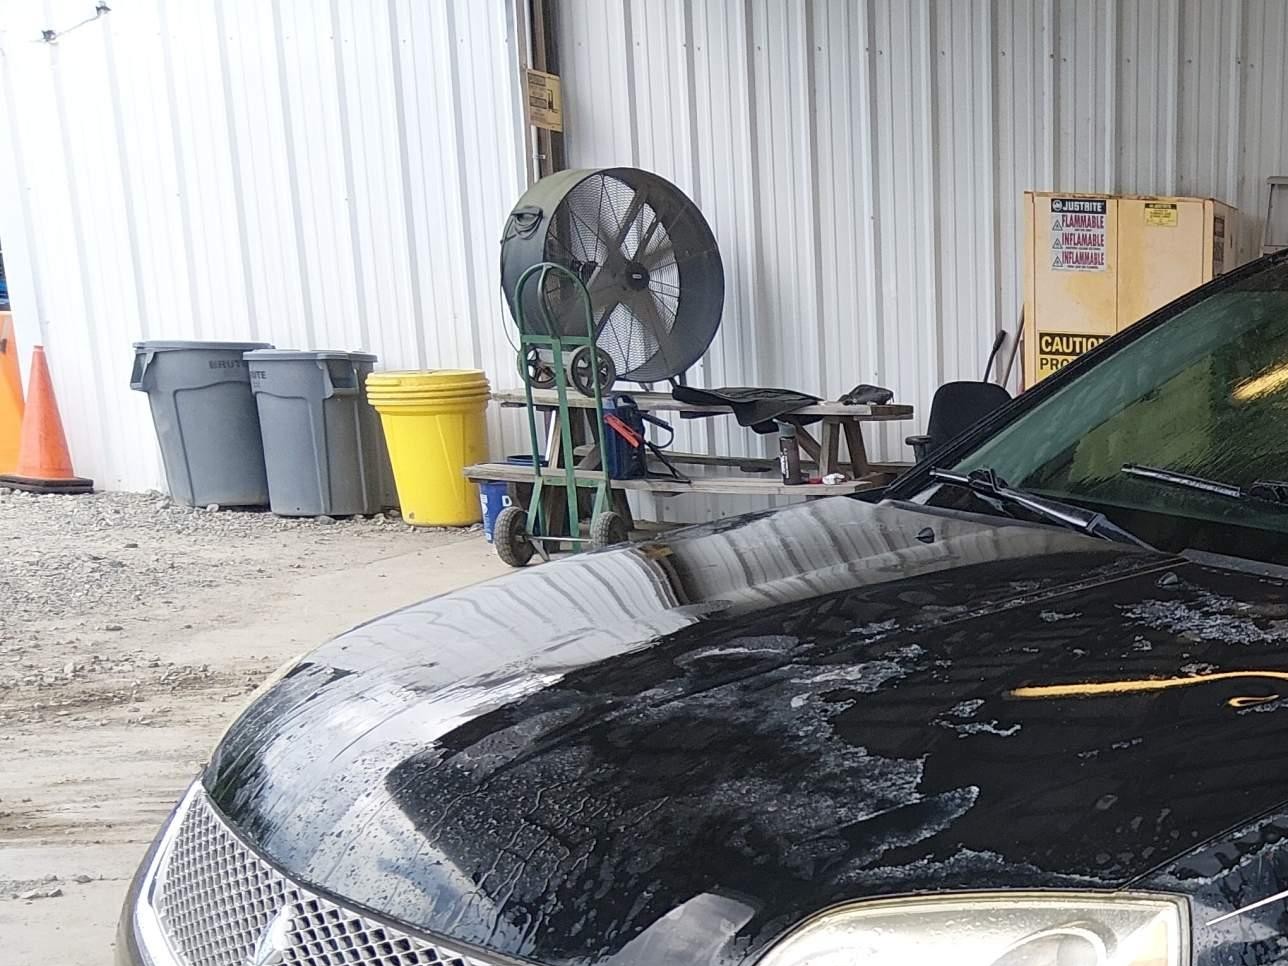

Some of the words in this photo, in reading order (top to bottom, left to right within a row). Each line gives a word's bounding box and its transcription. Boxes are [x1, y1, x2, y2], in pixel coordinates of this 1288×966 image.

[1062, 214, 1105, 229] FLAMMABLE
[1062, 232, 1105, 247] INFLAMABLE
[1062, 250, 1105, 265] INFLAMMABLE
